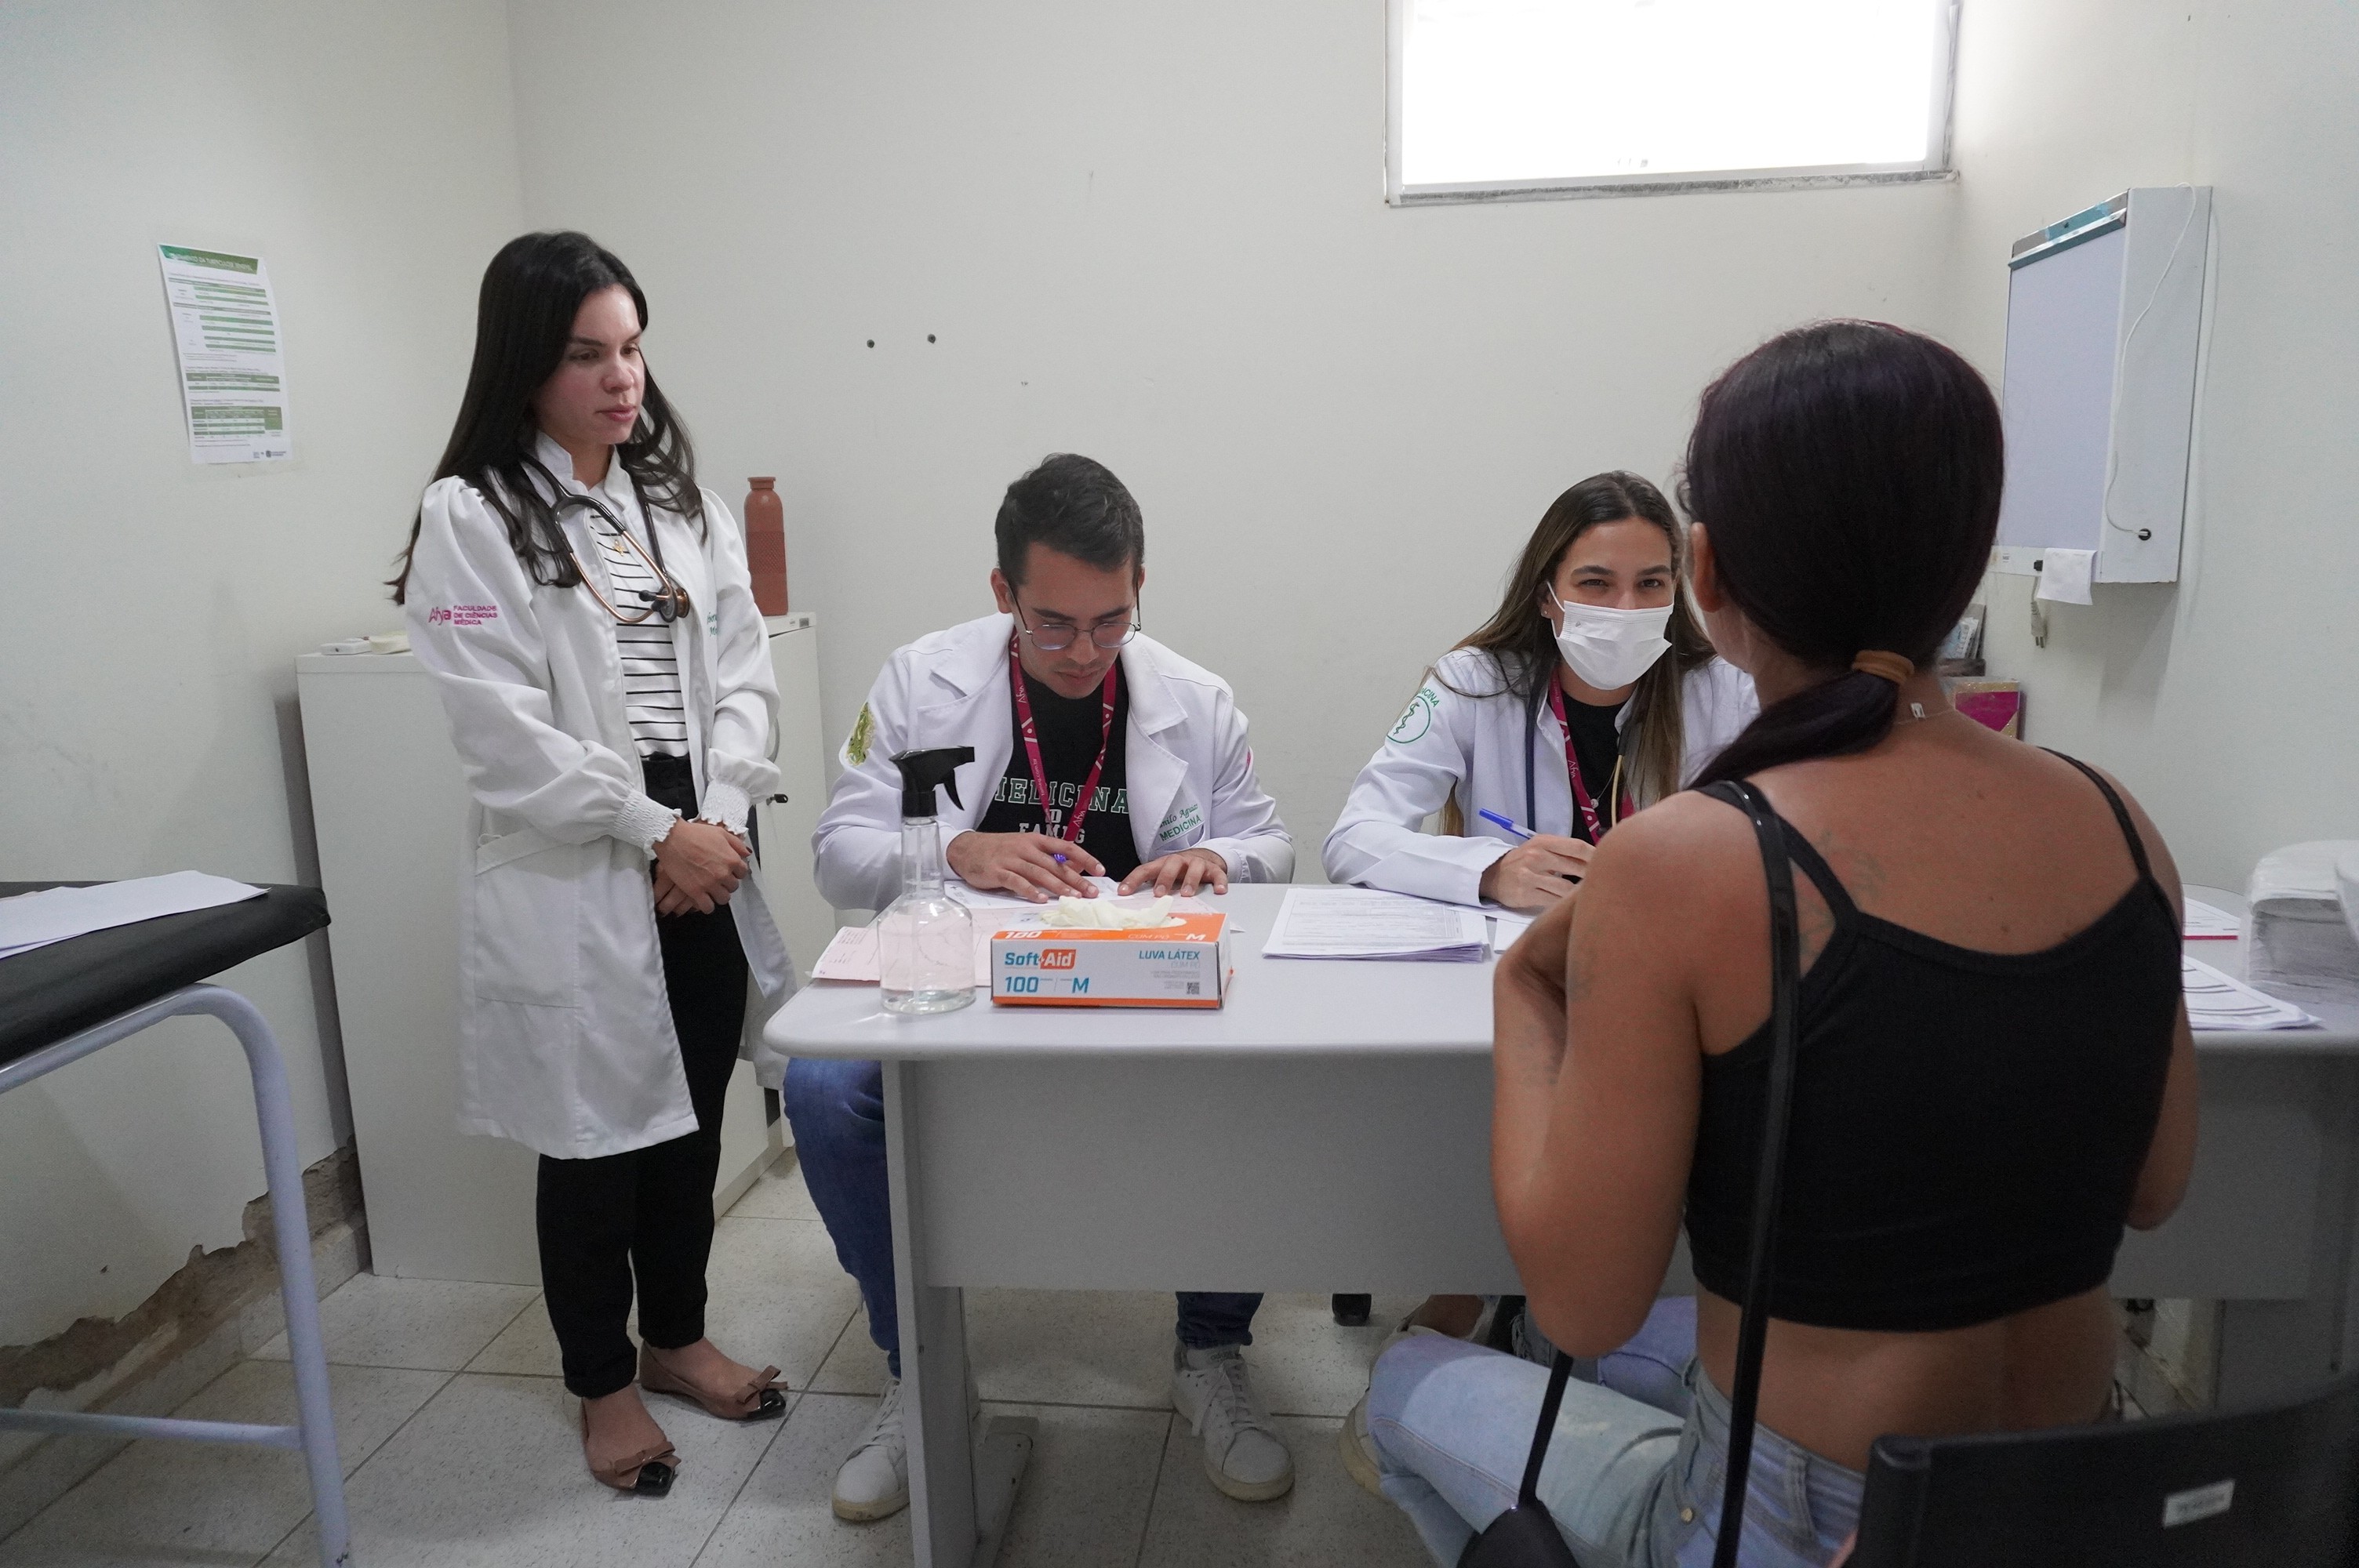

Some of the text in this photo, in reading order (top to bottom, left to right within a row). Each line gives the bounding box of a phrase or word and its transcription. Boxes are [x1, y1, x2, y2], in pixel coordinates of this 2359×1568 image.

[1159, 814, 1201, 841] MEDICINA
[1005, 931, 1042, 939] 100
[1139, 948, 1200, 960] LUVA LÁTEX
[1005, 976, 1039, 993] 100
[1071, 976, 1090, 994] M
